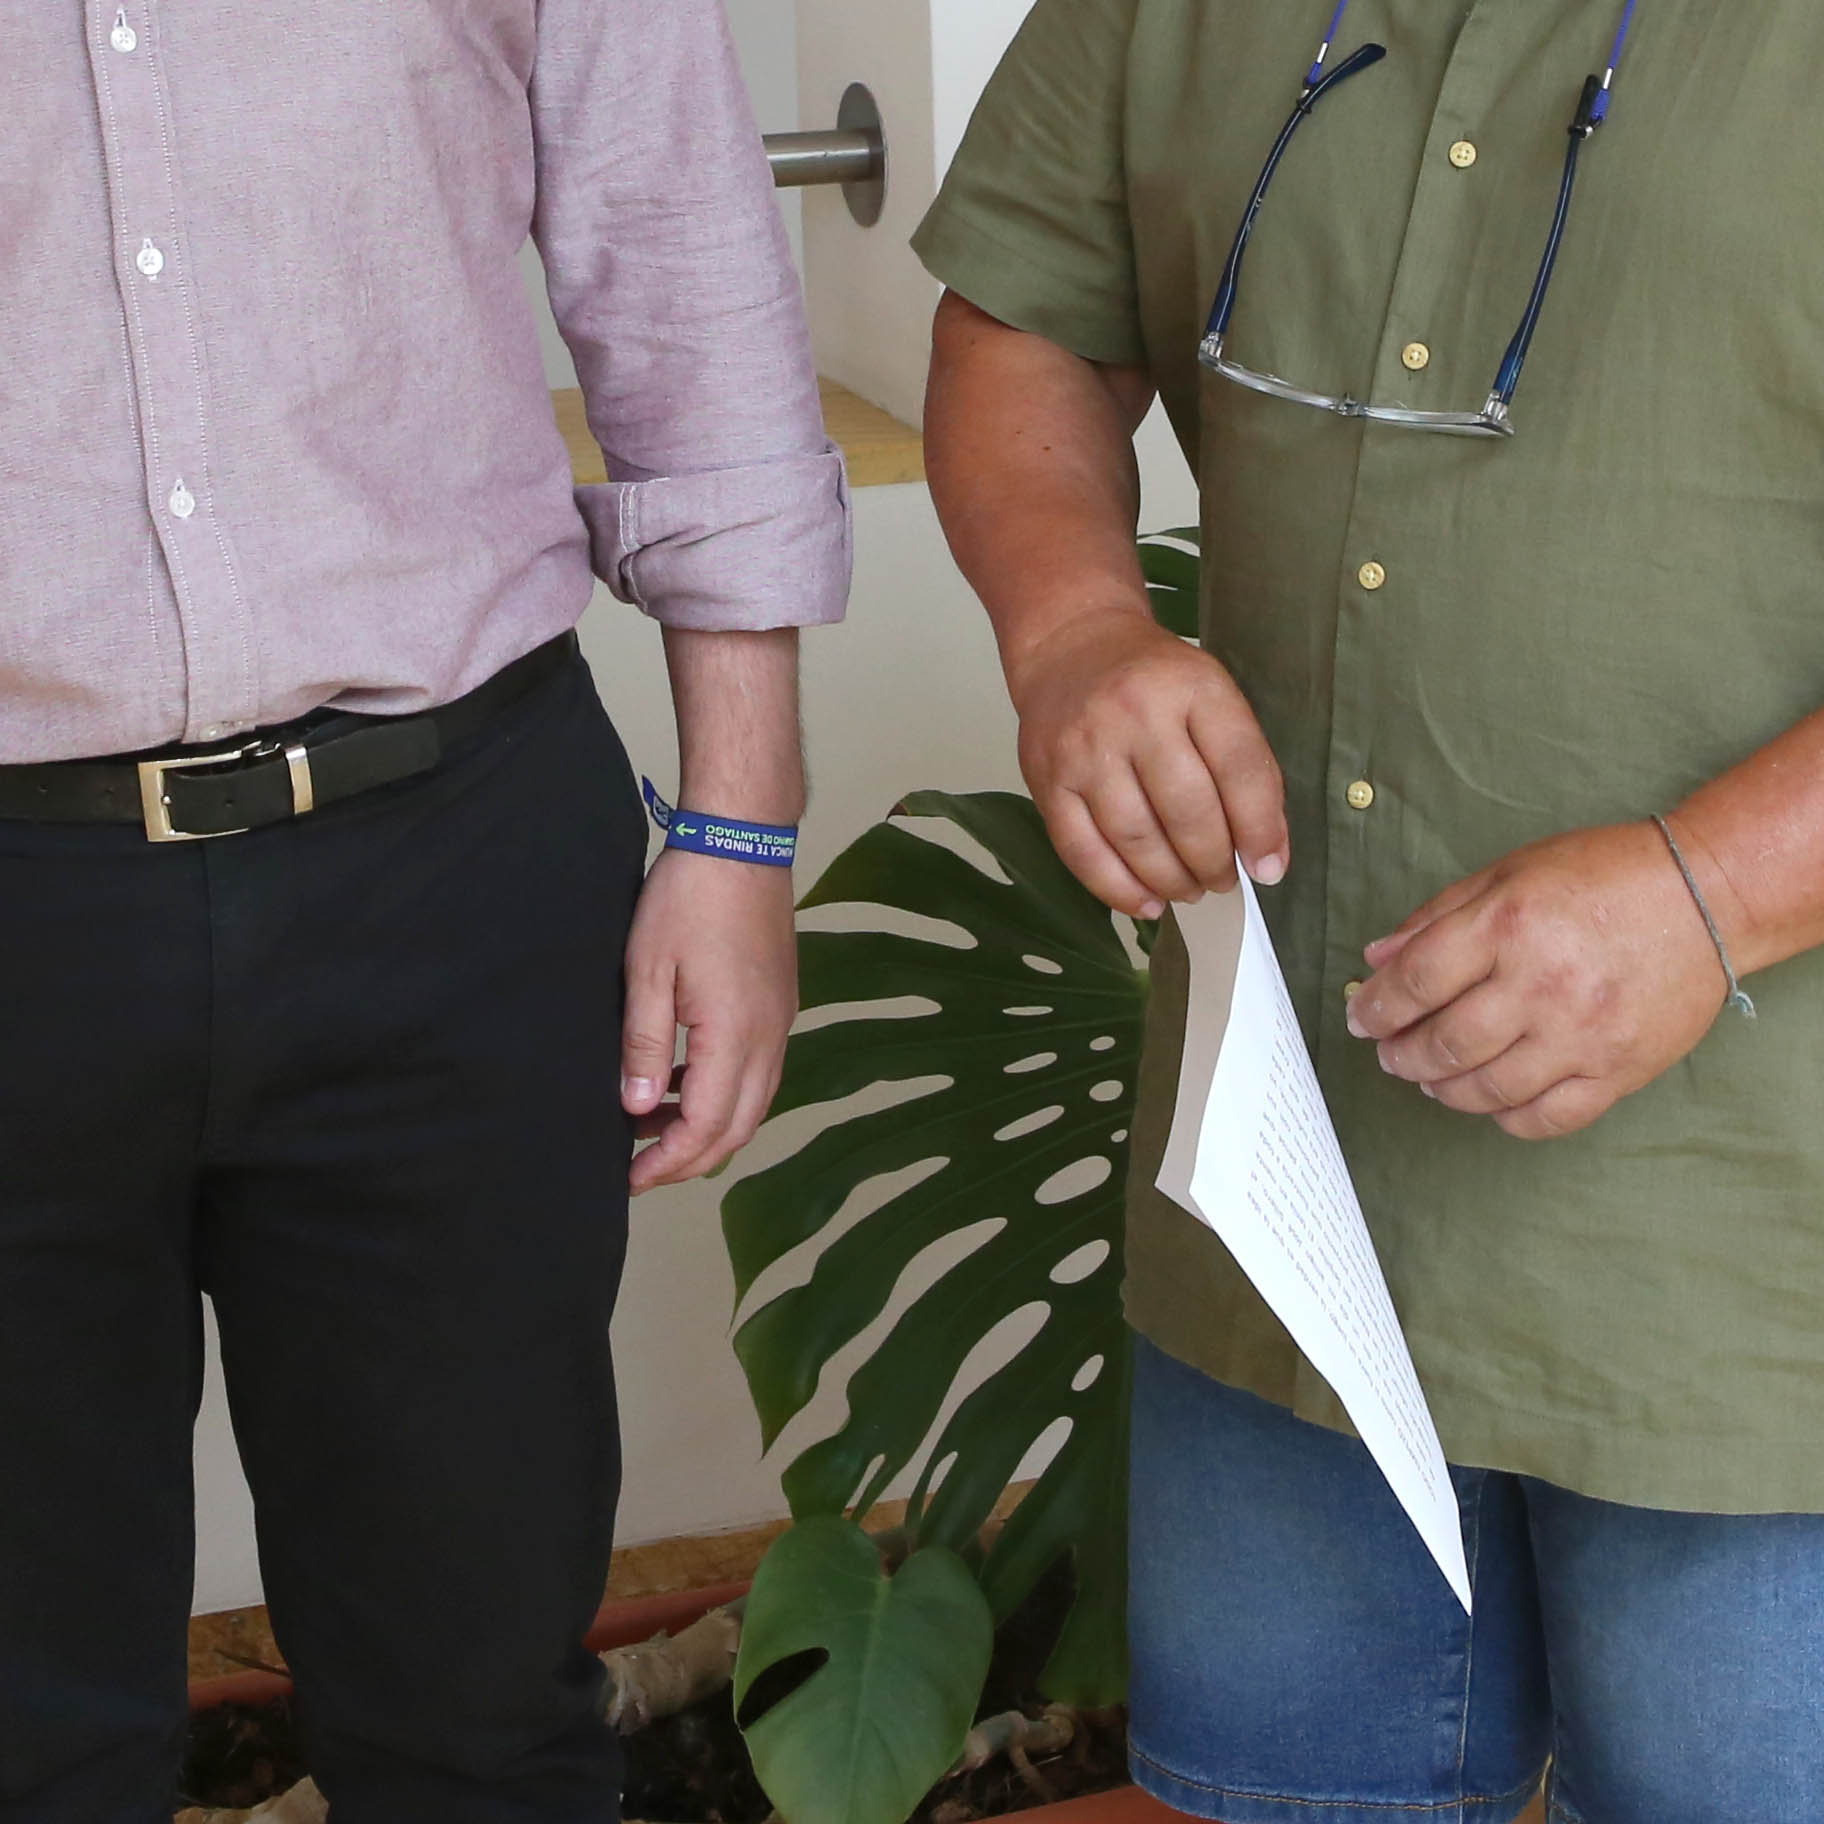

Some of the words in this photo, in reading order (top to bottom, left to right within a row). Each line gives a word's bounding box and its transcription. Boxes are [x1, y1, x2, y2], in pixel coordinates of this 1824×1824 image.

[705, 824, 760, 843] SANTIAGO
[762, 834, 773, 845] DE
[705, 835, 754, 853] RINDAS
[756, 843, 769, 856] TE
